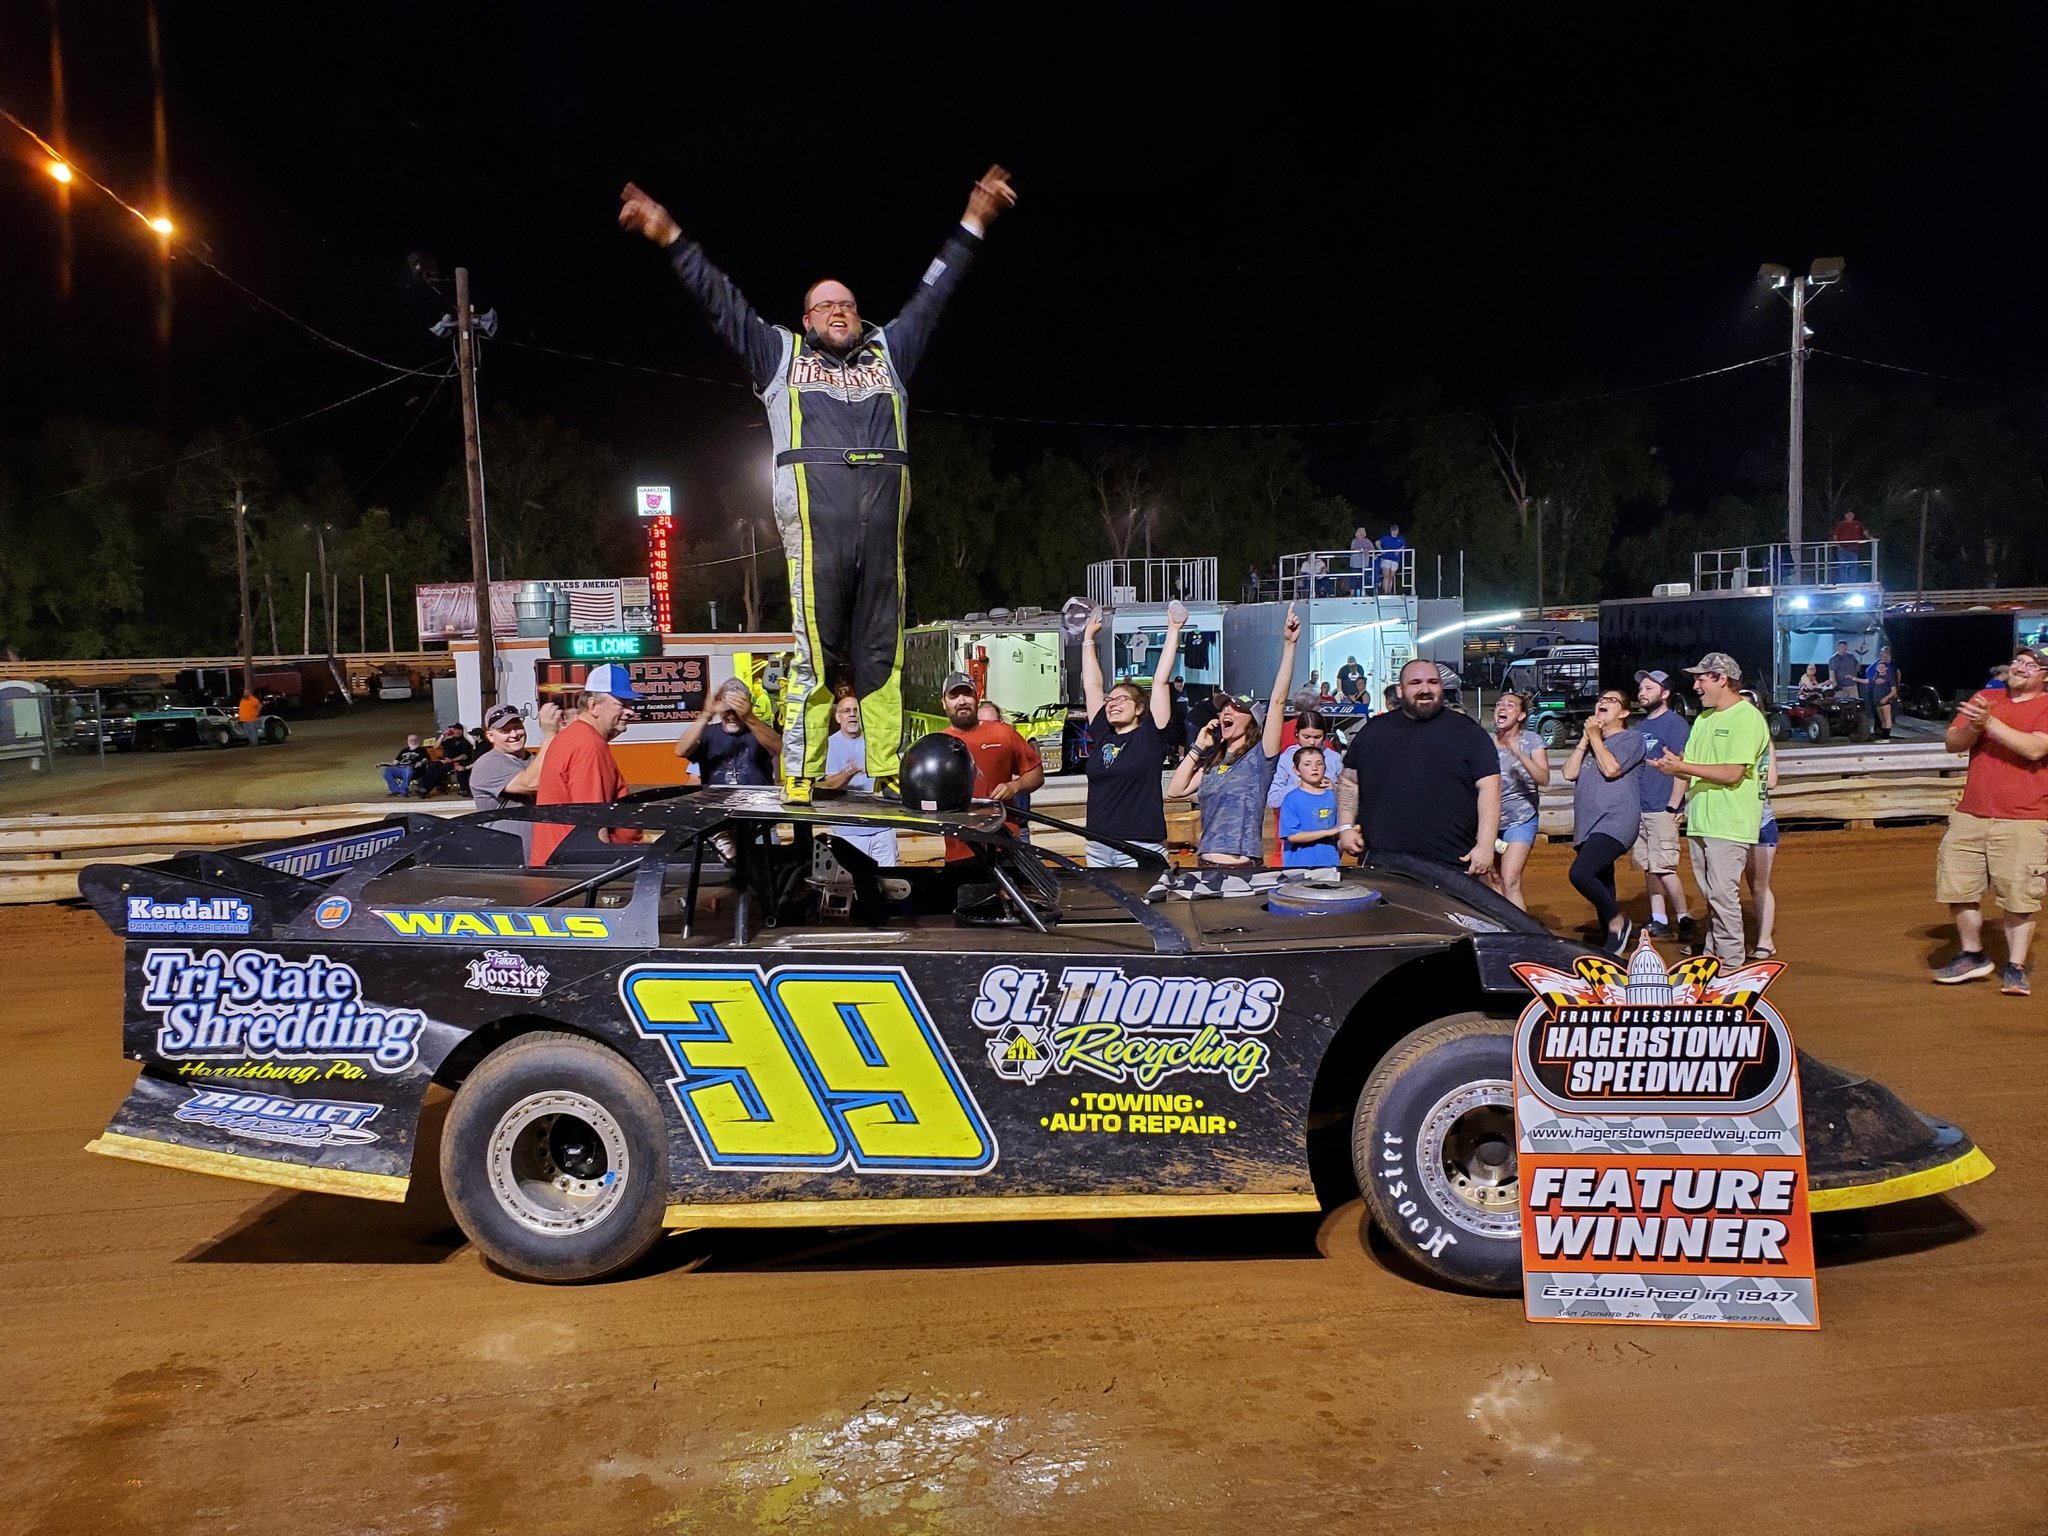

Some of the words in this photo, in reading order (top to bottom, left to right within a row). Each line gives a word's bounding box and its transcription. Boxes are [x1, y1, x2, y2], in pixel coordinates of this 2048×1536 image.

[658, 516, 671, 525] 20
[653, 528, 666, 538] 39
[659, 539, 666, 548] 8
[654, 550, 667, 559] 48
[655, 560, 667, 570] 92
[582, 580, 620, 588] AMERICA
[655, 571, 668, 580] 08
[656, 582, 669, 591] 82
[660, 624, 671, 633] 72
[572, 637, 640, 655] WELCOME
[630, 661, 701, 680] FER'S
[651, 711, 701, 720] TRAINING
[129, 899, 249, 920] Kendall's
[130, 922, 175, 931] PAINTING
[177, 923, 185, 931] &
[186, 923, 248, 932] FABRICATION
[382, 911, 610, 938] WALLS
[147, 953, 353, 1001] Tri-State
[469, 959, 547, 988] Hoosier
[490, 985, 521, 993] RACING
[976, 968, 1042, 1025] St.
[1057, 968, 1279, 1031] Thomas
[1560, 1009, 1612, 1023] FRANK
[1621, 1009, 1744, 1023] PLESSINGER'S
[162, 1000, 419, 1061] Shredding
[1545, 1026, 1761, 1058] HAGERSTOWN
[1054, 1023, 1267, 1085] Recycling
[325, 1060, 368, 1080] Pa.
[626, 972, 991, 1168] 39
[1570, 1061, 1739, 1093] SPEEDWAY
[196, 1089, 375, 1126] ROCKET
[1082, 1093, 1193, 1113] TOWING
[1050, 1113, 1121, 1132] AUTO
[1129, 1115, 1226, 1134] REPAIR
[1533, 1126, 1782, 1142] www.hagerstownspeedway.com
[1378, 1131, 1458, 1258] Hoosier
[1529, 1167, 1797, 1213] FEATURE
[1535, 1215, 1788, 1261] WINNER
[1542, 1285, 1699, 1300] Established
[1705, 1289, 1728, 1301] in
[1736, 1290, 1797, 1303] 1947
